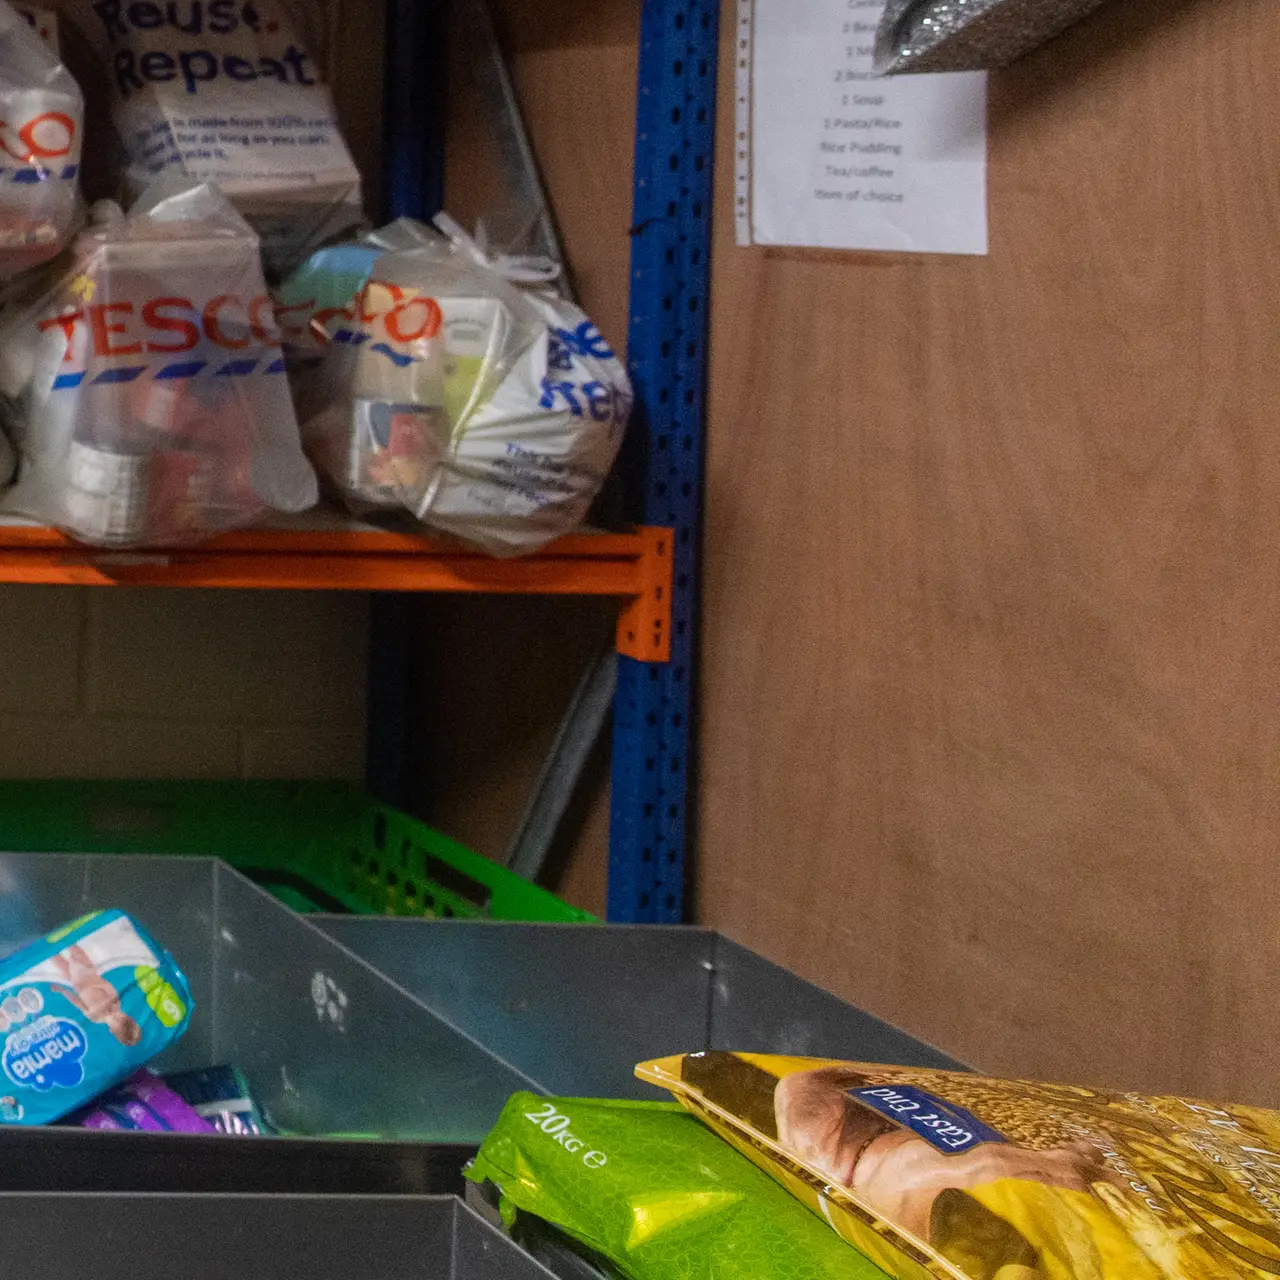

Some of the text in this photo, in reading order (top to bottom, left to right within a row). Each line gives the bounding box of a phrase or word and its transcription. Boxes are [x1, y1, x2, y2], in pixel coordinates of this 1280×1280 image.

[10, 1029, 81, 1084] mamia
[524, 1102, 585, 1154] 20KG
[859, 1085, 975, 1150] East End
